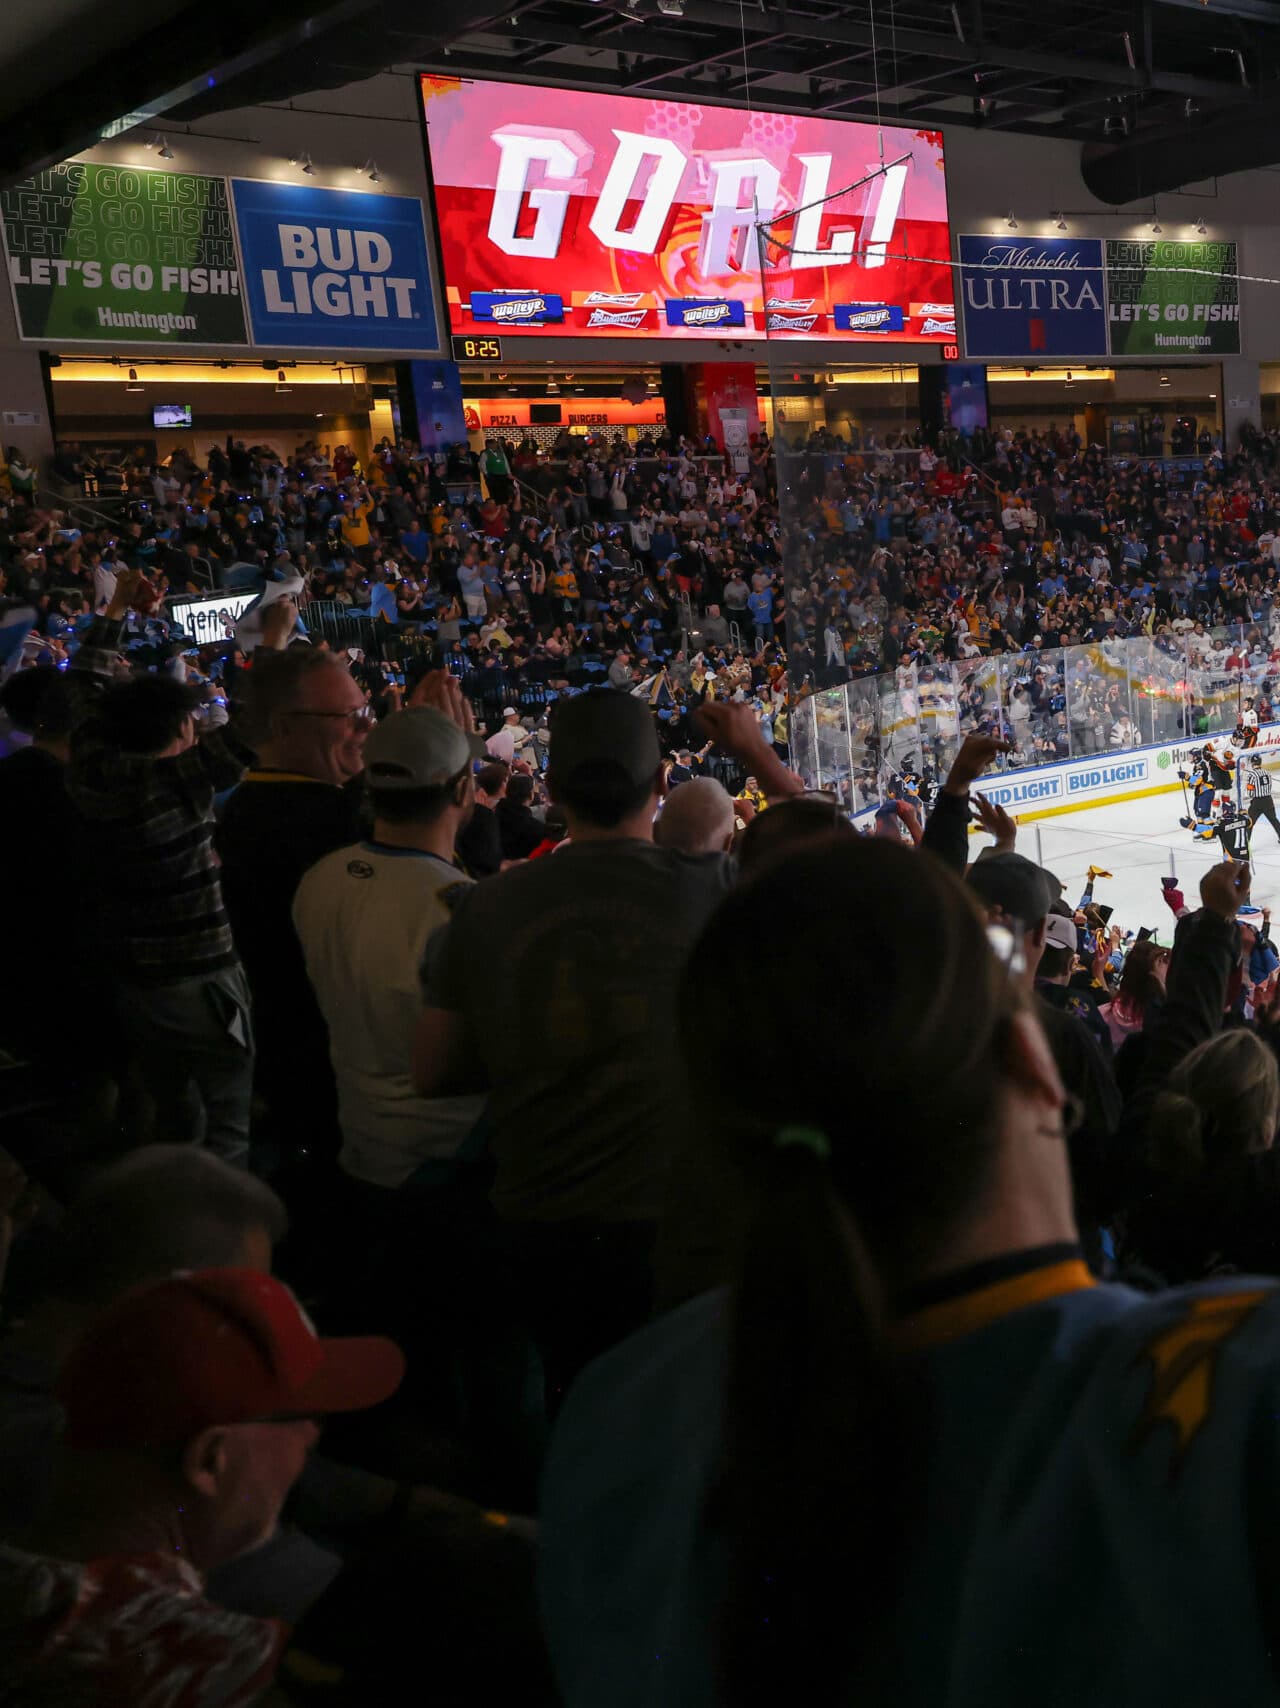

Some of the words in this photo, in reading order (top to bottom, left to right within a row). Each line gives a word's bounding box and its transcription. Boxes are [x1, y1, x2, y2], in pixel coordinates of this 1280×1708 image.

[96, 168, 141, 199] GO
[148, 173, 227, 209] FISH!
[487, 123, 908, 277] GOAL!
[3, 191, 93, 226] LET'S
[100, 200, 145, 230] GO
[151, 204, 232, 238] FISH!
[6, 223, 98, 257] LET'S
[104, 231, 149, 260] GO
[156, 235, 236, 267] FISH!
[277, 222, 393, 274] BUD
[982, 245, 1081, 272] Michelob
[1107, 241, 1157, 262] LET'S
[1160, 242, 1187, 264] GO
[1190, 242, 1238, 264] FISH!
[10, 256, 103, 288] LET'S
[110, 262, 154, 290] GO
[161, 266, 240, 295] FISH!
[261, 269, 417, 319] LIGHT
[964, 278, 1103, 310] ULTRA
[97, 306, 197, 334] Huntington
[492, 298, 546, 320] Walleye
[683, 304, 731, 324] Walleye
[848, 310, 891, 327] Walleye
[1109, 304, 1160, 322] LET'S
[1164, 304, 1189, 322] GO
[1193, 304, 1240, 322] FISH!
[465, 340, 499, 358] 8:25
[1154, 333, 1212, 350] Huntington
[490, 414, 518, 426] PIZZA
[568, 413, 608, 425] BURGERS
[1069, 771, 1101, 791] BUD
[1103, 762, 1146, 786] LIGHT
[984, 790, 1012, 807] UD
[1013, 779, 1060, 801] LIGHT
[1234, 827, 1247, 848] 11
